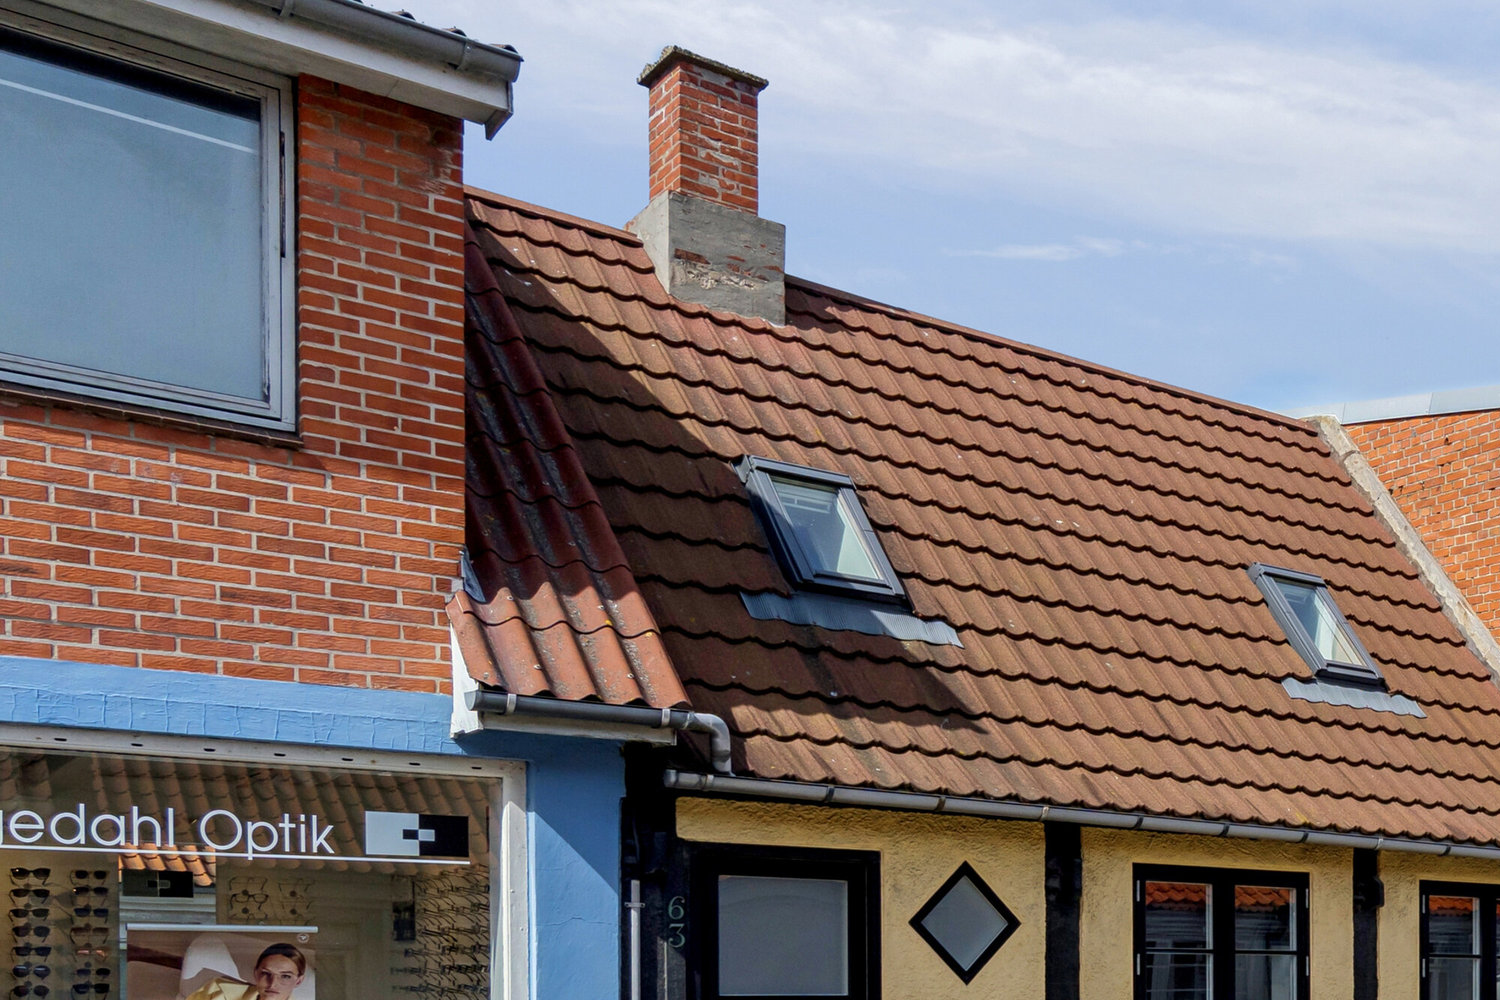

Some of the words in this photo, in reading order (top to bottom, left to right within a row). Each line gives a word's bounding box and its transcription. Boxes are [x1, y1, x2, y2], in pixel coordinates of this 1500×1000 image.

[0, 803, 175, 848] edahl
[200, 809, 335, 861] Optik
[668, 895, 686, 948] 63
